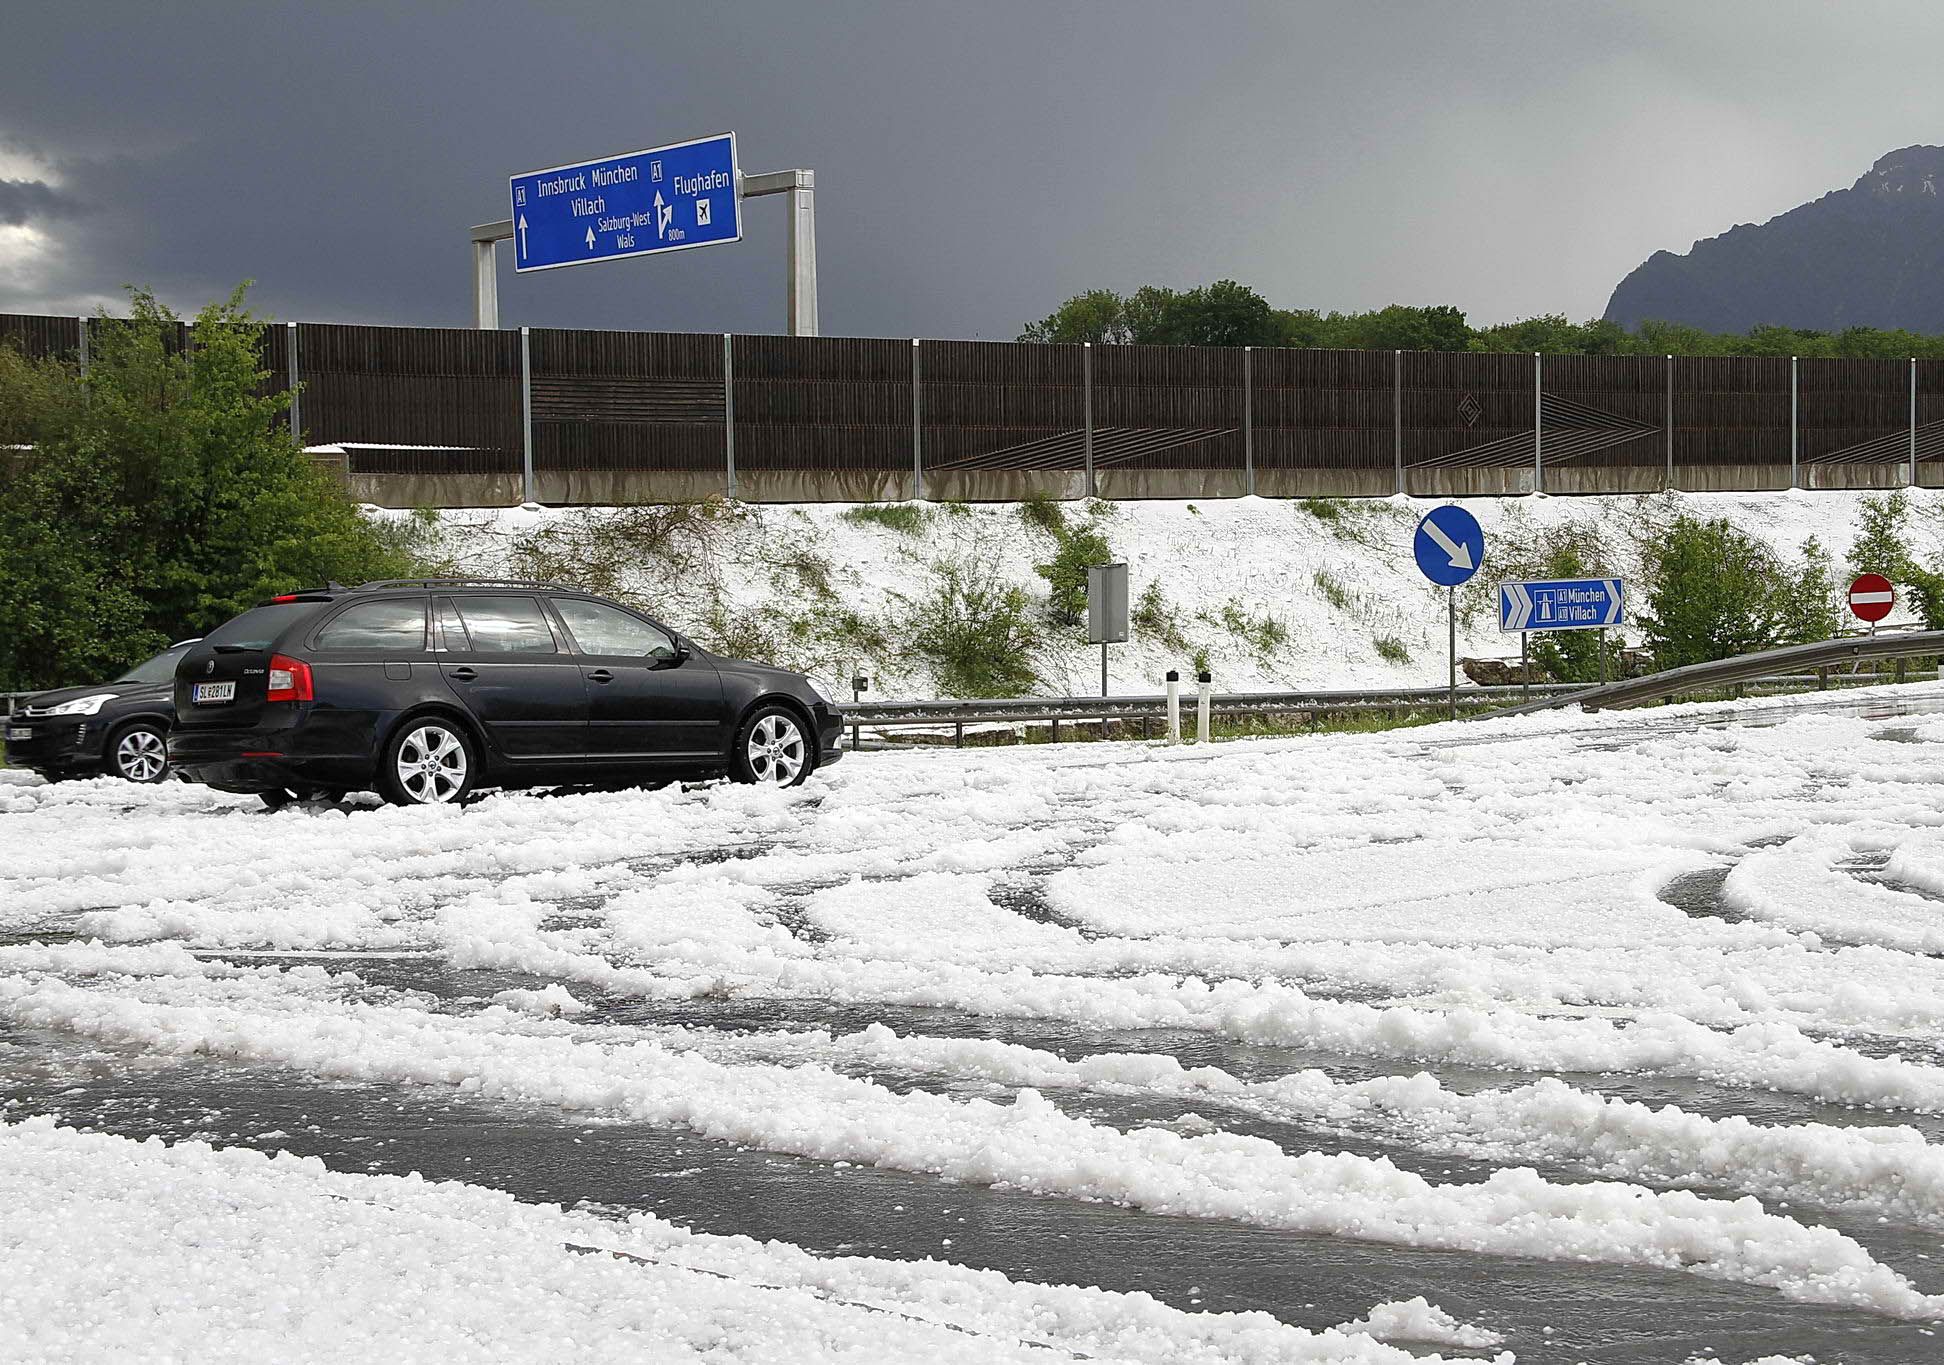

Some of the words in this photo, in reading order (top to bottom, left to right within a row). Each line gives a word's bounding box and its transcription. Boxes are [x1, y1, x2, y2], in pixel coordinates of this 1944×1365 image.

[652, 163, 661, 179] A1
[537, 173, 586, 198] Innsbruck
[592, 165, 638, 188] München
[674, 170, 730, 196] Flughafen
[516, 188, 526, 204] A1
[571, 196, 606, 217] Villach
[598, 211, 651, 232] Salzburg-West
[616, 234, 635, 249] Wals
[1558, 590, 1567, 602] A1
[1568, 588, 1605, 603] München
[1569, 606, 1597, 620] Villach
